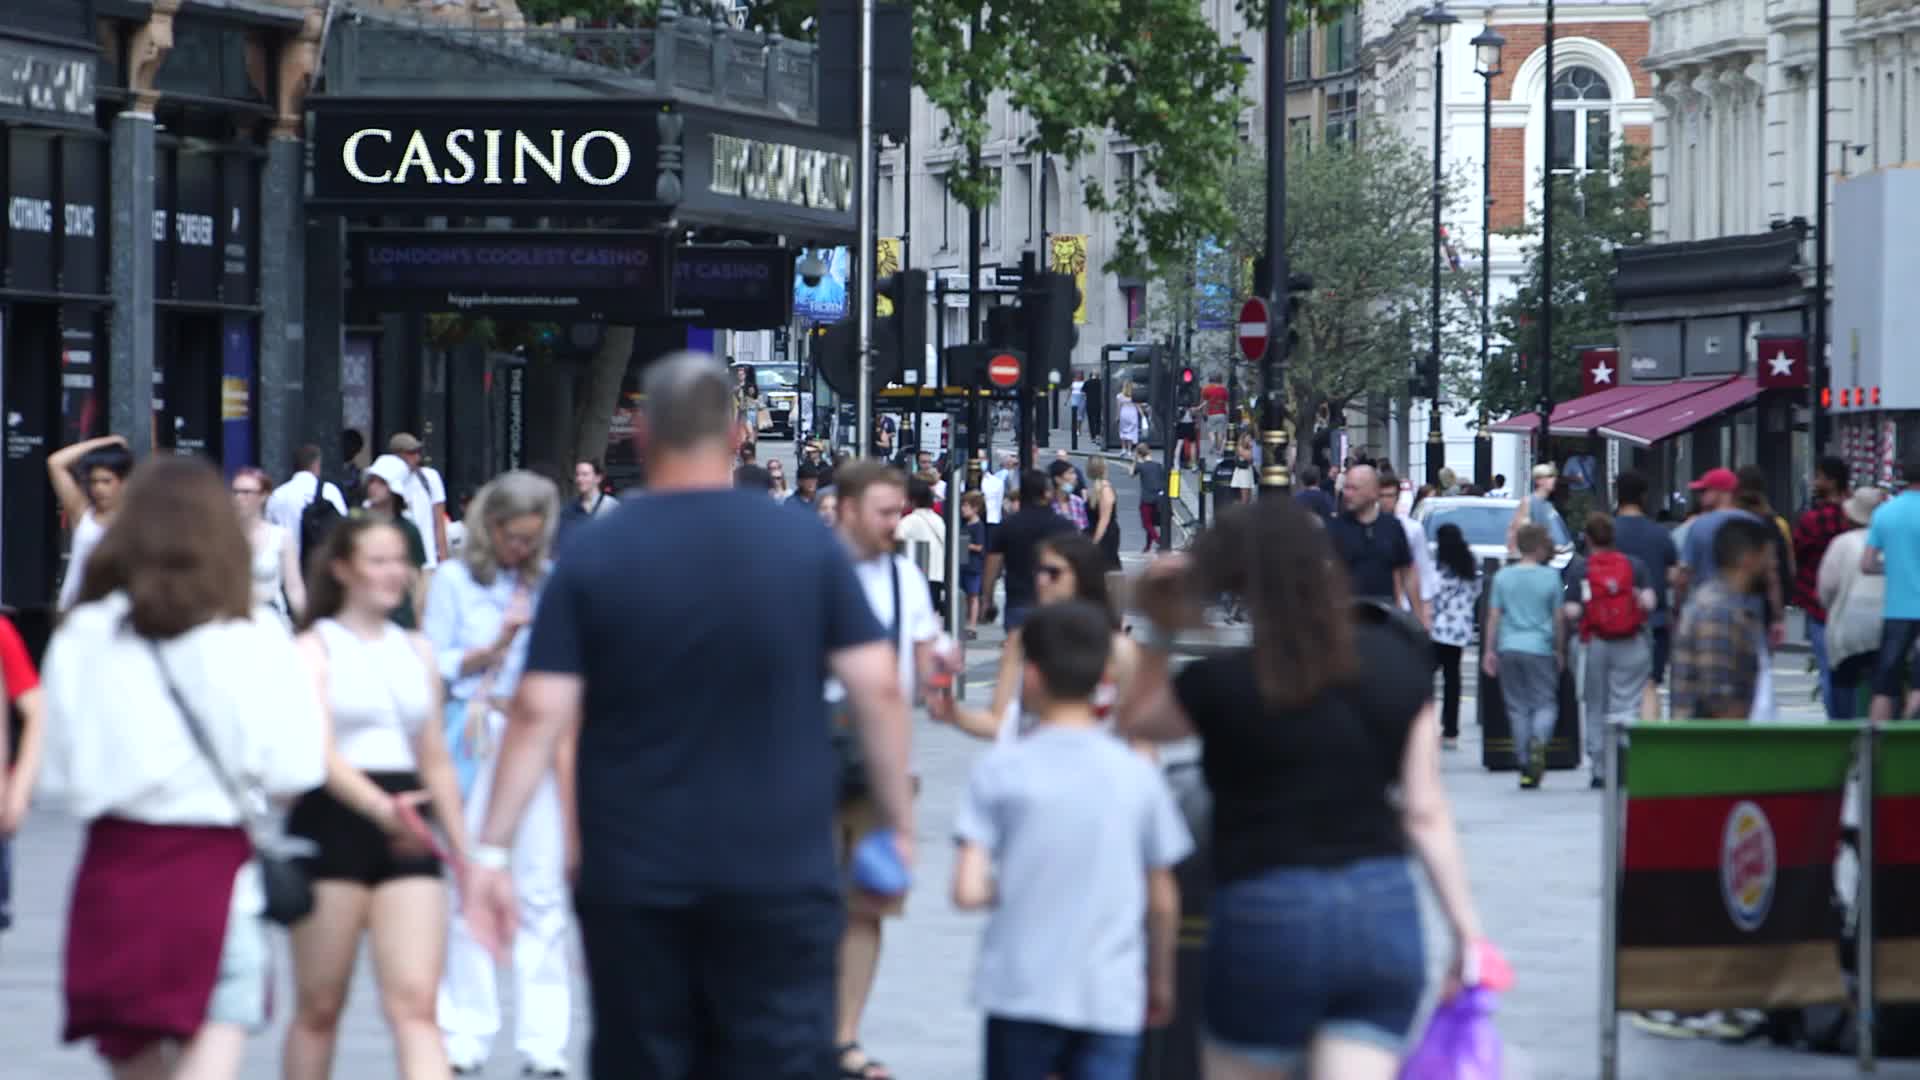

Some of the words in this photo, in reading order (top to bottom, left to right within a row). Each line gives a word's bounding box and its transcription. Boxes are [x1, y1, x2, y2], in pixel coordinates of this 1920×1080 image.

[342, 128, 632, 186] CASINO
[8, 196, 53, 232] NOTHING
[64, 203, 96, 238] STAYS
[368, 248, 473, 265] LONDON'S
[476, 248, 567, 265] COOLEST
[570, 249, 648, 265] CASINO
